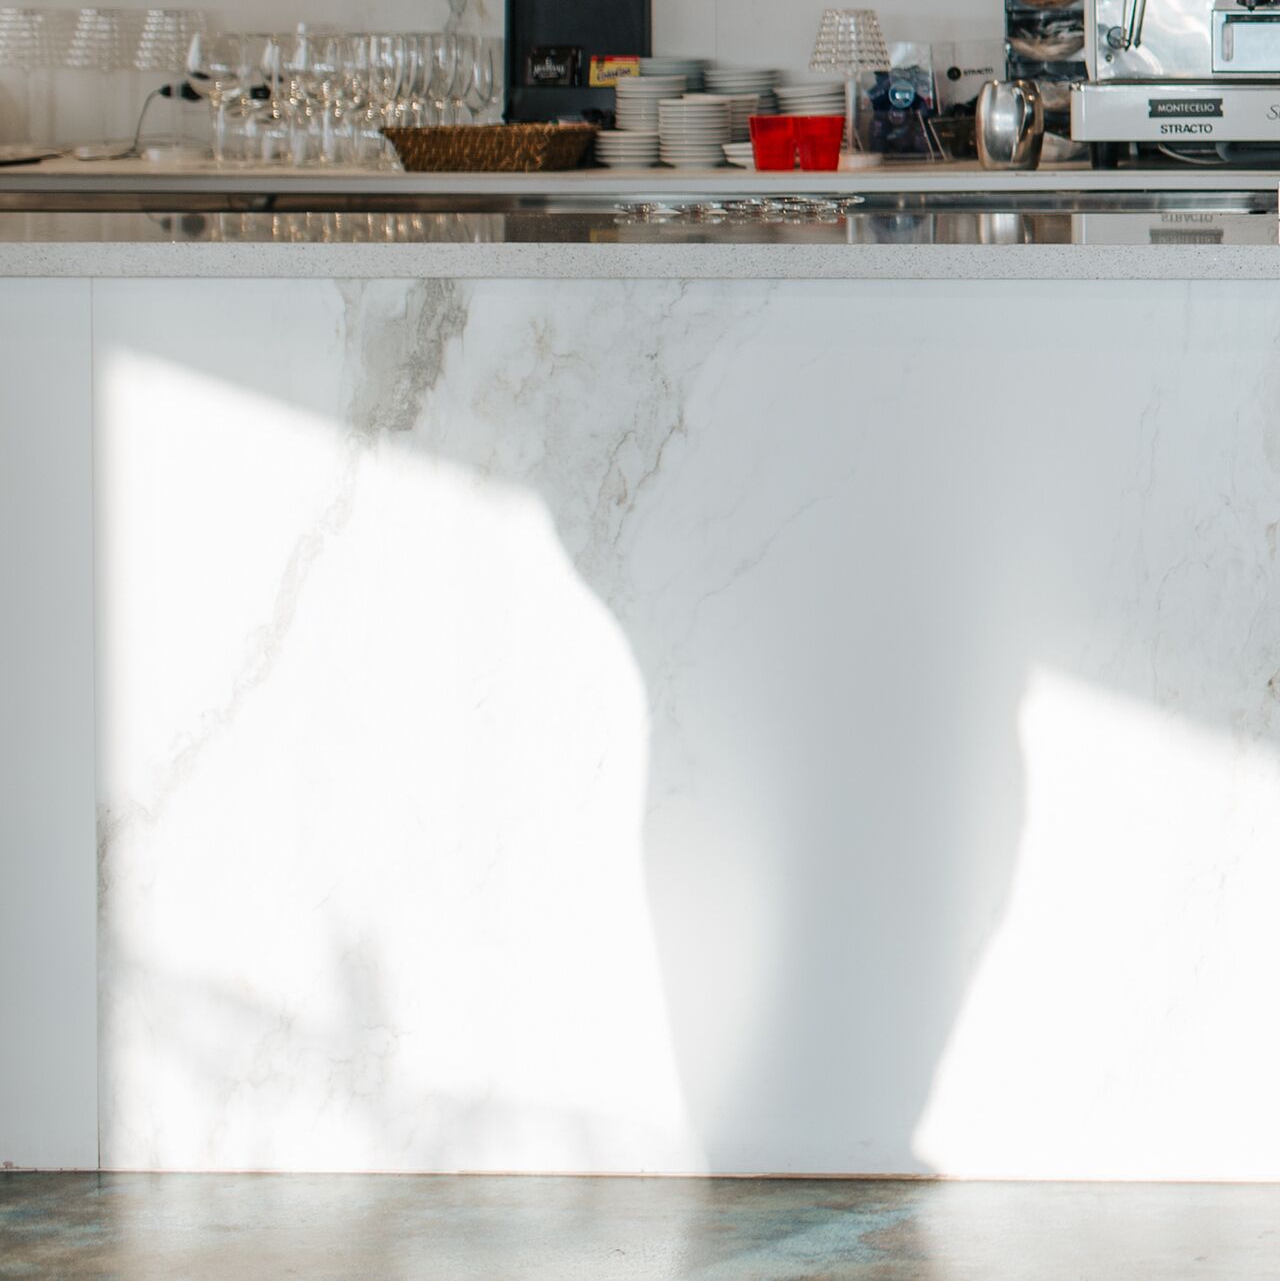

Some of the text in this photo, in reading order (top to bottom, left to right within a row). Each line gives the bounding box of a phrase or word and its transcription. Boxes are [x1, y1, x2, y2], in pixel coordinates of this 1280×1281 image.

[962, 66, 994, 76] STRACTO
[1157, 103, 1215, 113] MONTECELIO
[1160, 124, 1213, 134] STRACTO
